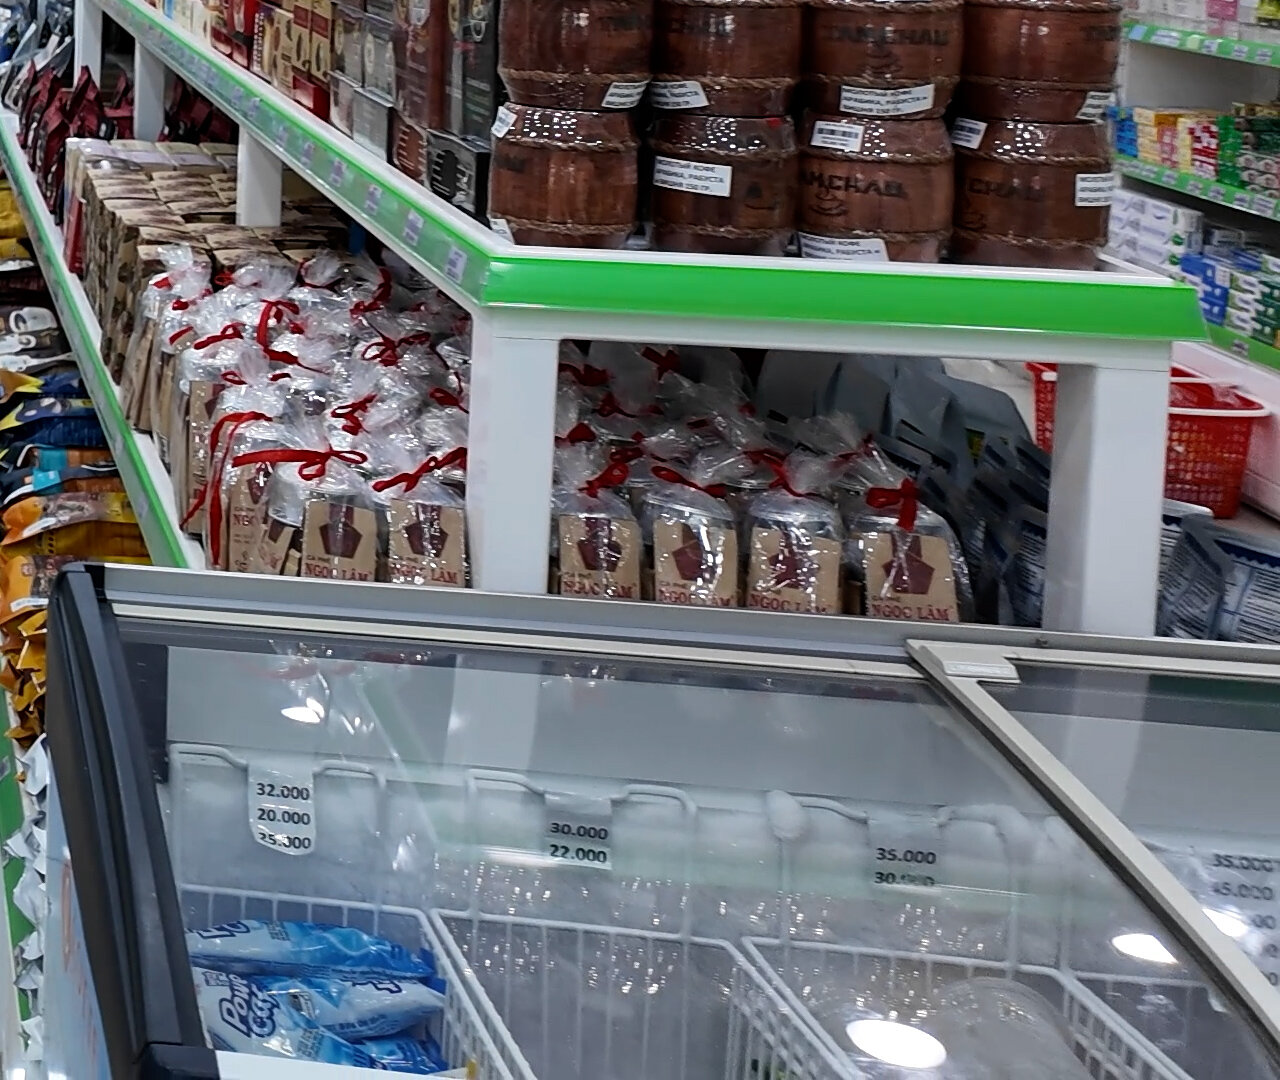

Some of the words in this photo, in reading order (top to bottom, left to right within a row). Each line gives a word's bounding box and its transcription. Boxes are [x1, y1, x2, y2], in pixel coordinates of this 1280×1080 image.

[256, 781, 310, 802] 32.000
[257, 808, 311, 827] 20.000
[549, 821, 609, 841] 30.000
[549, 844, 608, 865] 22.000
[875, 847, 937, 865] 35.000
[1212, 853, 1274, 872] 35.000
